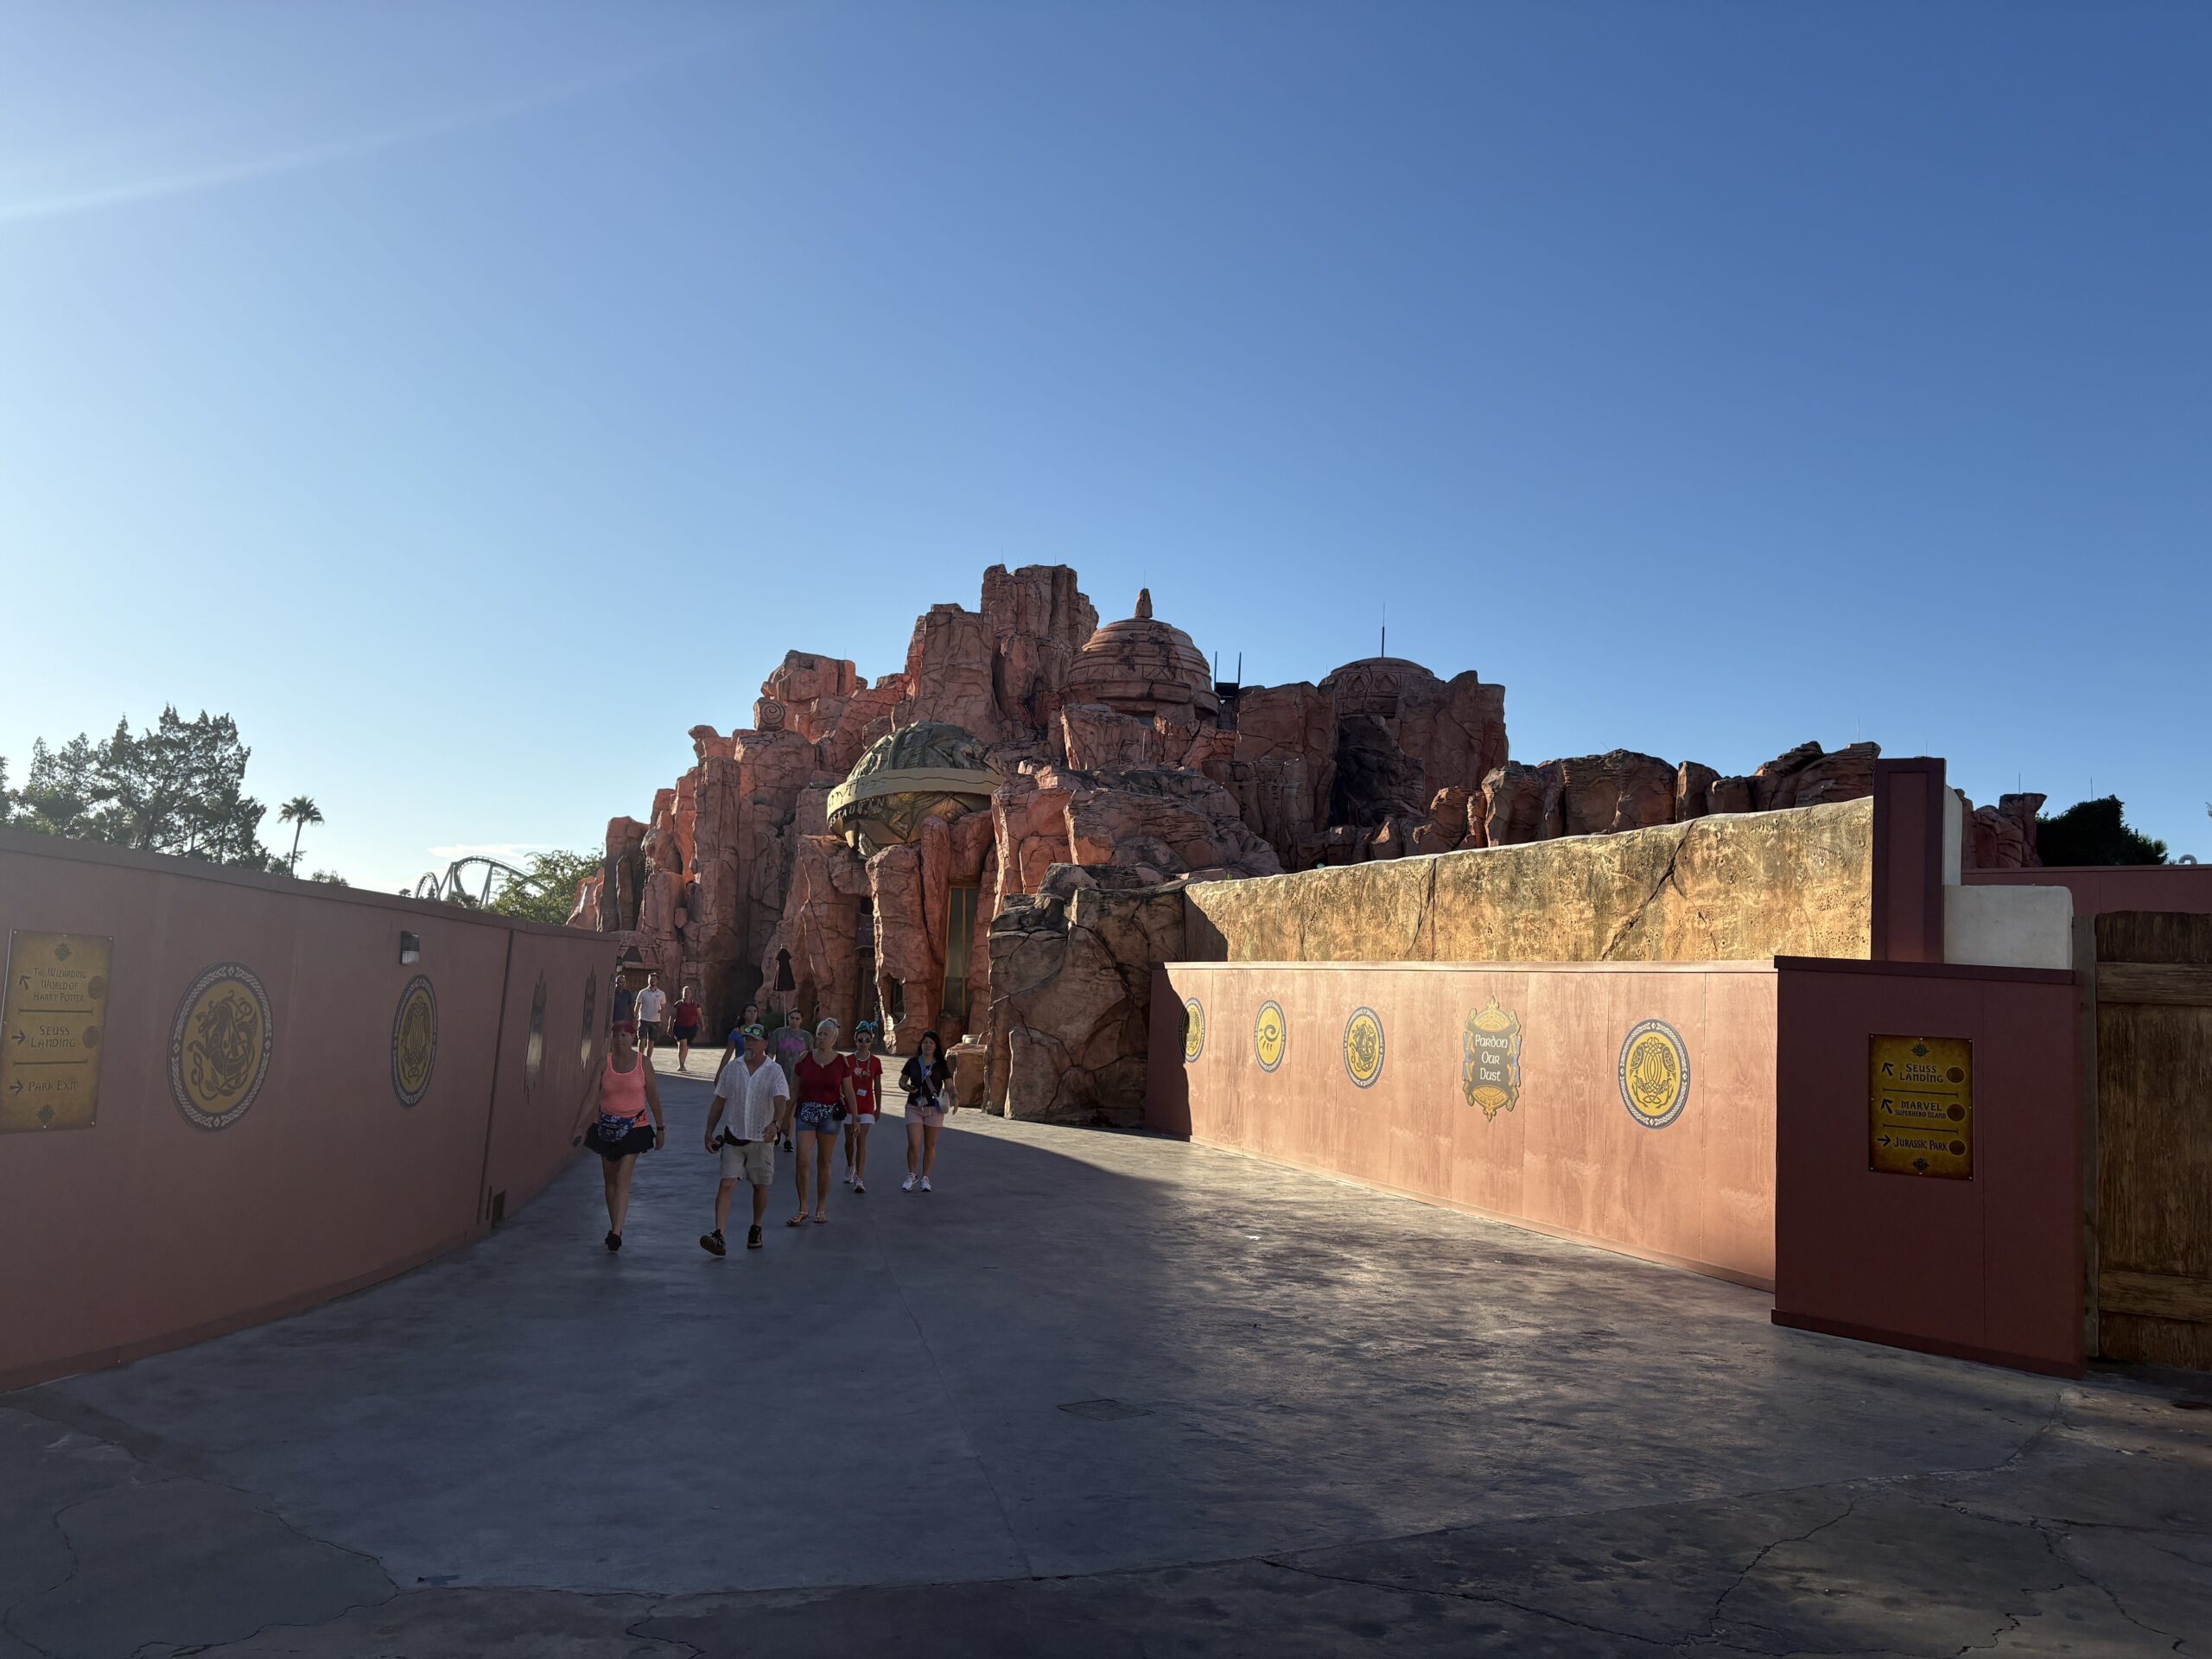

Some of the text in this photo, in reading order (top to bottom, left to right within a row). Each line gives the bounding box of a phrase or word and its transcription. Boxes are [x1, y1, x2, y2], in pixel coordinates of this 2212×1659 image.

[48, 968, 86, 979] WIZARDING
[41, 979, 67, 990] WORLD
[34, 992, 84, 1002] HARRY POTTER
[39, 1025, 70, 1036] SEUSS
[30, 1038, 76, 1048] LANDING
[1475, 1033, 1508, 1048] Pardon
[1481, 1051, 1500, 1065] Our
[1906, 1063, 1937, 1072] SEUSS
[1479, 1067, 1501, 1082] Dust
[1899, 1072, 1943, 1083] LANDING
[28, 1080, 78, 1092] PARK EXIT
[1901, 1101, 1942, 1111] MARVEL
[1894, 1136, 1948, 1152] JURASSIC PARK
